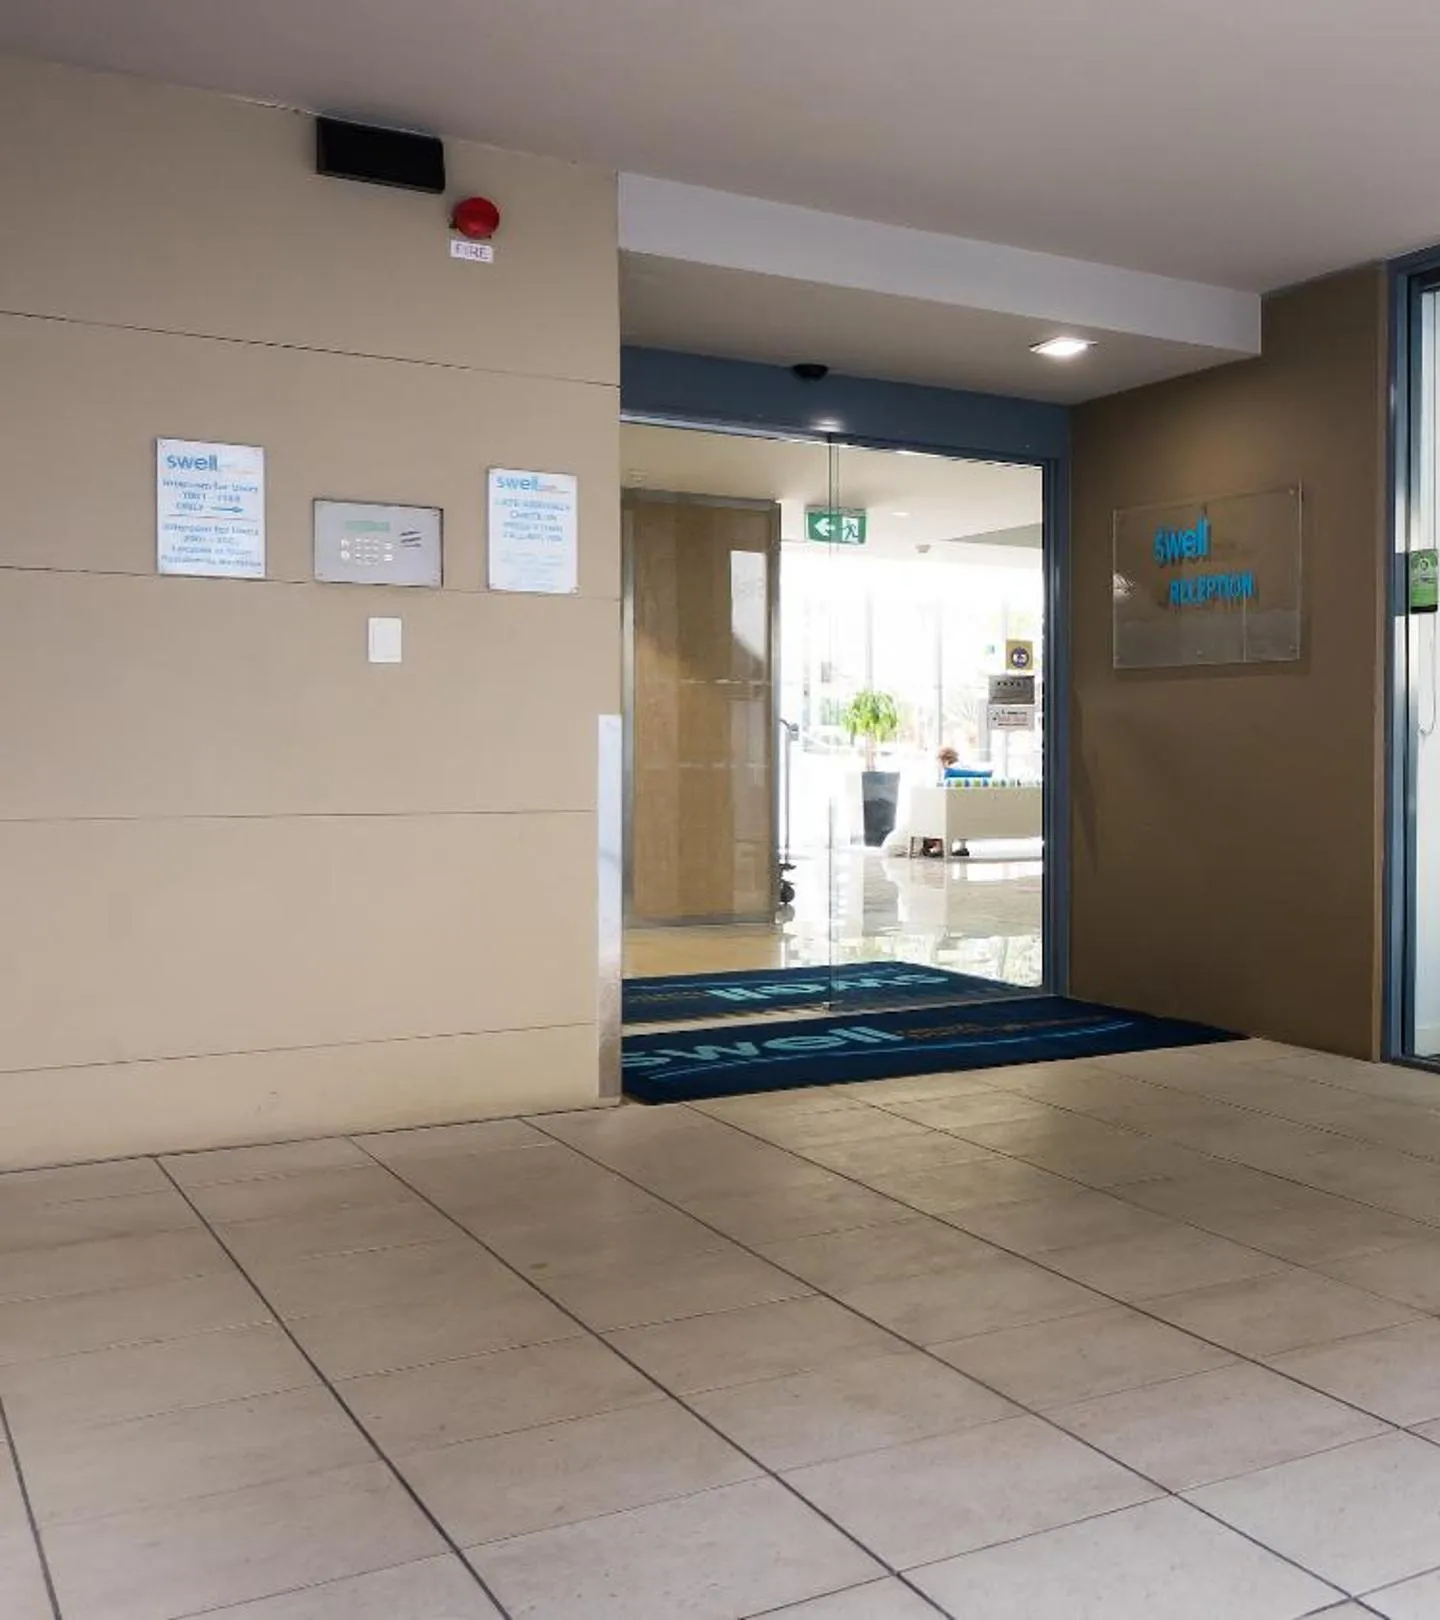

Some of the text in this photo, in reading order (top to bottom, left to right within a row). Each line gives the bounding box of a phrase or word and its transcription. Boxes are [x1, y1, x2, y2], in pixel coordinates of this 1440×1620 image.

[454, 243, 490, 260] FIRE
[166, 454, 218, 471] swell
[1154, 516, 1209, 565] swell
[621, 1026, 904, 1068] swell
